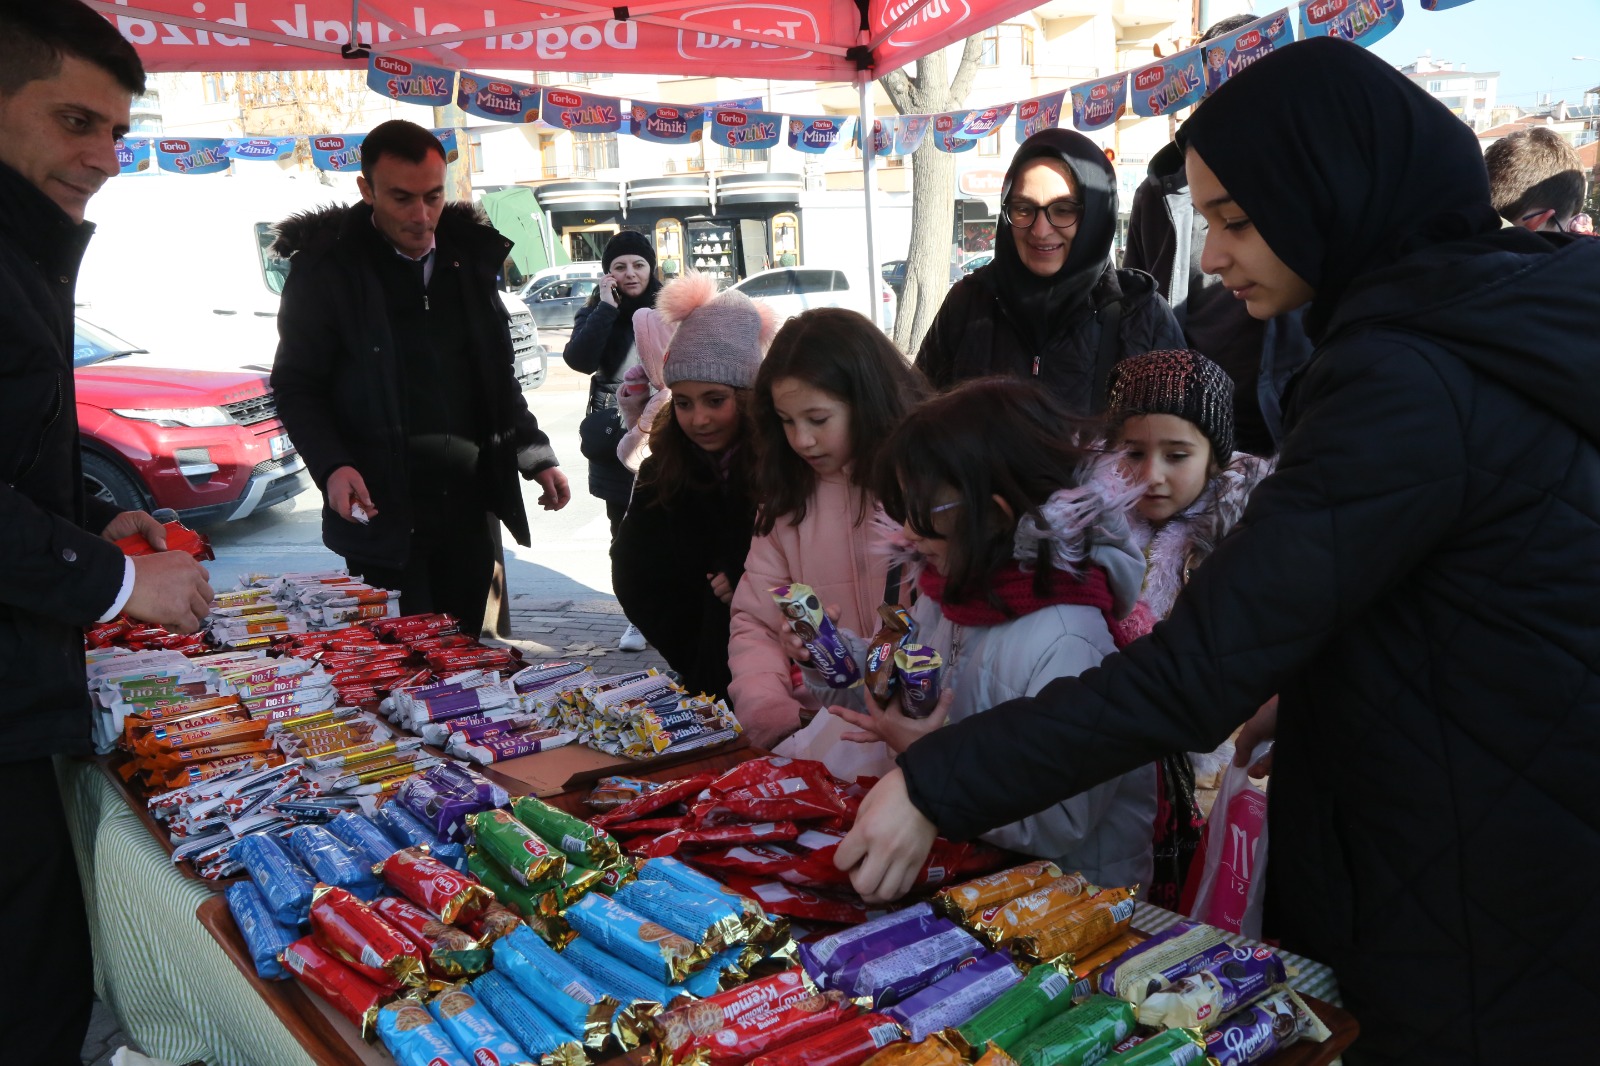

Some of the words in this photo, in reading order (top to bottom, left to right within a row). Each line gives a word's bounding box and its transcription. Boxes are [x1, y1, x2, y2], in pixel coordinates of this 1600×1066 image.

[1310, 0, 1346, 20] Torku
[1237, 33, 1259, 49] Torku
[379, 58, 408, 73] Torku
[1137, 70, 1162, 88] Torku
[490, 83, 510, 94] Torku
[1091, 87, 1107, 98] Torku
[476, 92, 521, 112] Miniki
[551, 94, 578, 105] Torku
[659, 110, 676, 118] Torku
[983, 110, 998, 119] Torku
[1020, 104, 1038, 117] Torku
[1084, 98, 1114, 119] Miniki
[720, 113, 744, 124] Torku
[814, 121, 831, 129] Torku
[965, 119, 996, 131] Miniki
[647, 118, 686, 134] Miniki
[316, 139, 341, 148] Torku
[803, 131, 840, 143] Miniki
[163, 142, 187, 151] Torku
[236, 145, 277, 156] Miniki
[274, 679, 293, 691] no:1
[266, 694, 285, 707] no:1
[273, 706, 291, 718] no:1
[665, 709, 694, 725] Miniki
[185, 716, 220, 730] daha
[470, 717, 486, 726] no:1
[674, 724, 703, 739] Miniki
[494, 735, 529, 750] no:1
[517, 742, 535, 753] no:1
[435, 877, 454, 892] Torku
[605, 872, 615, 884] Tor
[723, 984, 779, 1018] Kremalı
[757, 1016, 780, 1030] Bisküvi
[1116, 1036, 1143, 1051] Torku
[1224, 1023, 1271, 1062] Premio
